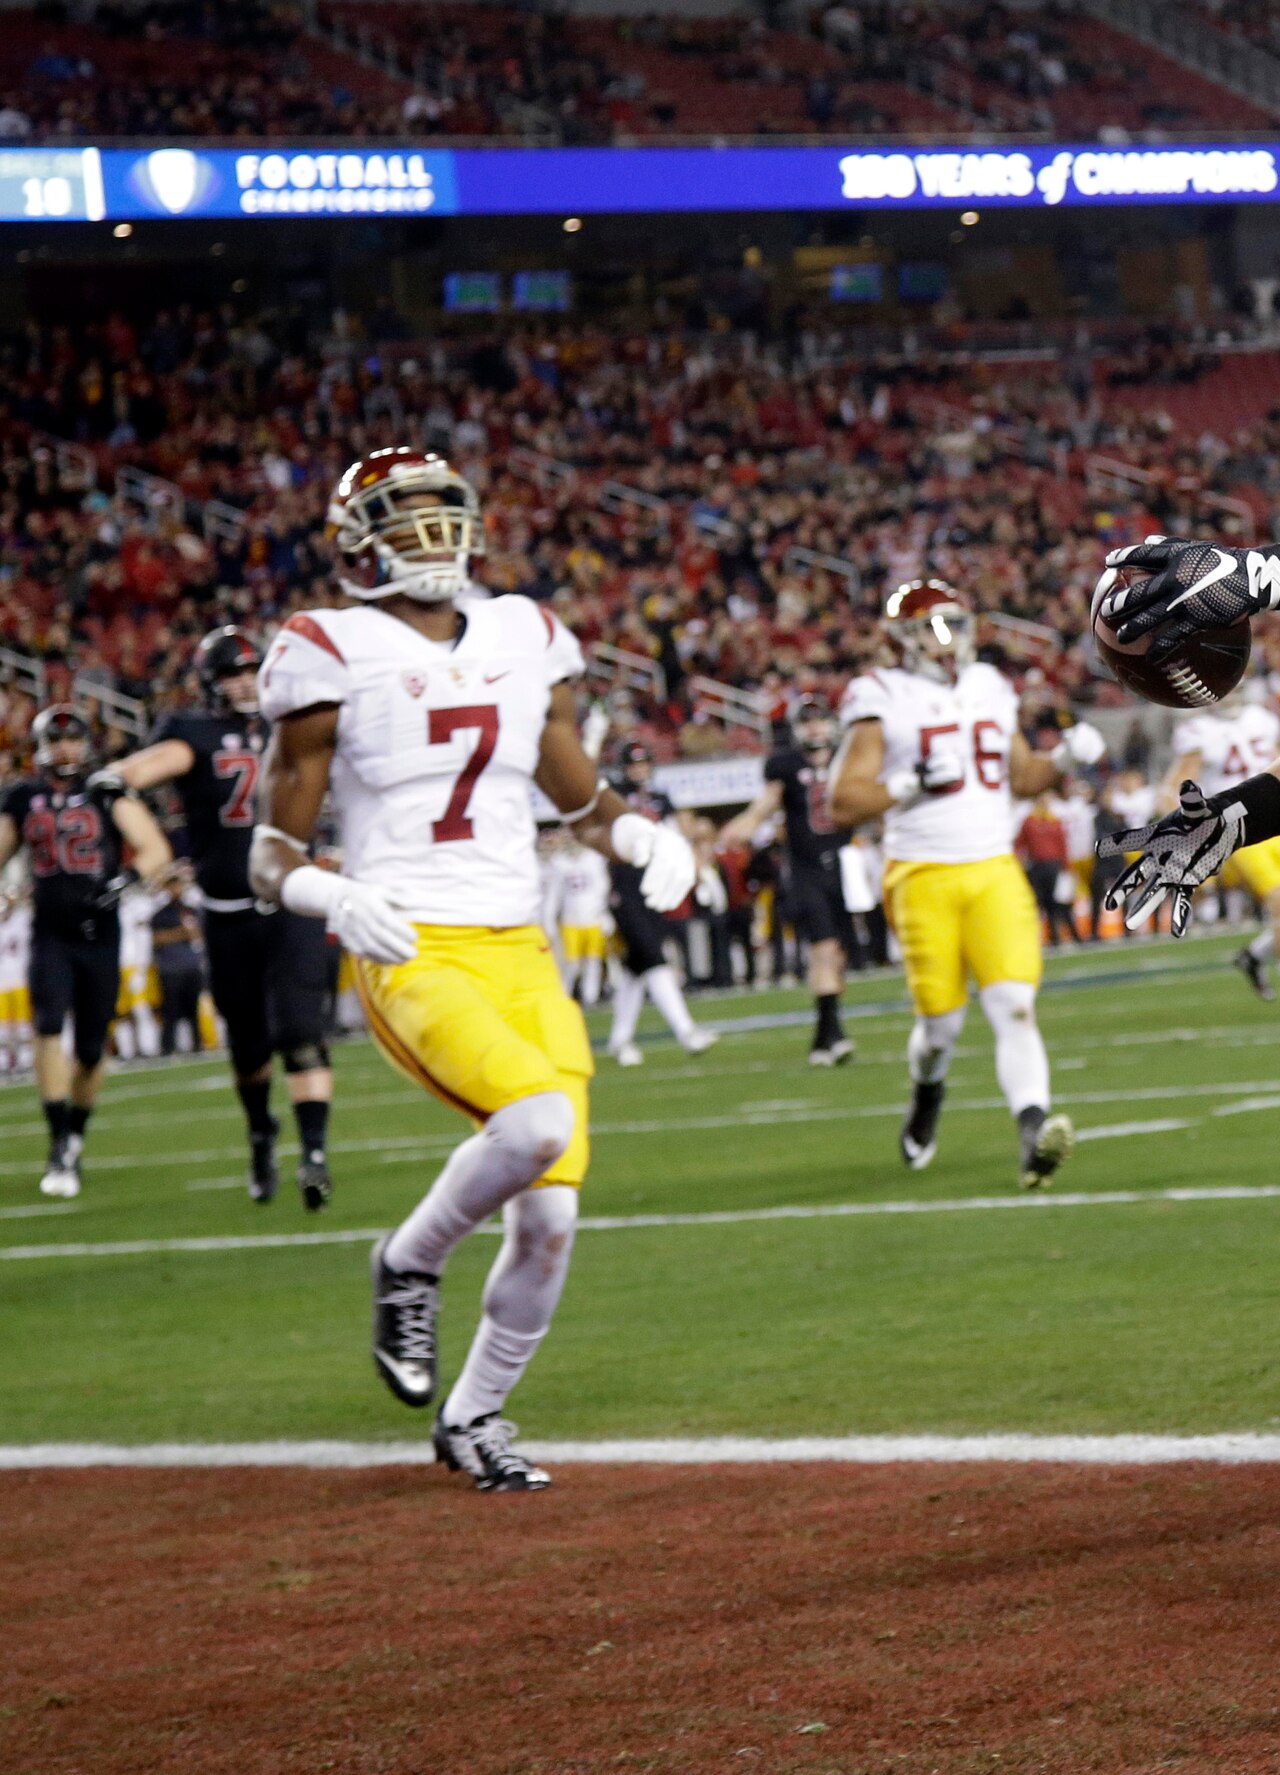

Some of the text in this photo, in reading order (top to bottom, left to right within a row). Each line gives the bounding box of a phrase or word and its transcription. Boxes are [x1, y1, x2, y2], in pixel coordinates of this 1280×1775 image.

[235, 154, 433, 189] FOOTBALL
[914, 153, 1036, 198] YEARS
[1036, 151, 1074, 205] of
[1072, 150, 1279, 195] CHAMPIONS
[427, 703, 500, 843] 7
[919, 720, 1006, 793] 56
